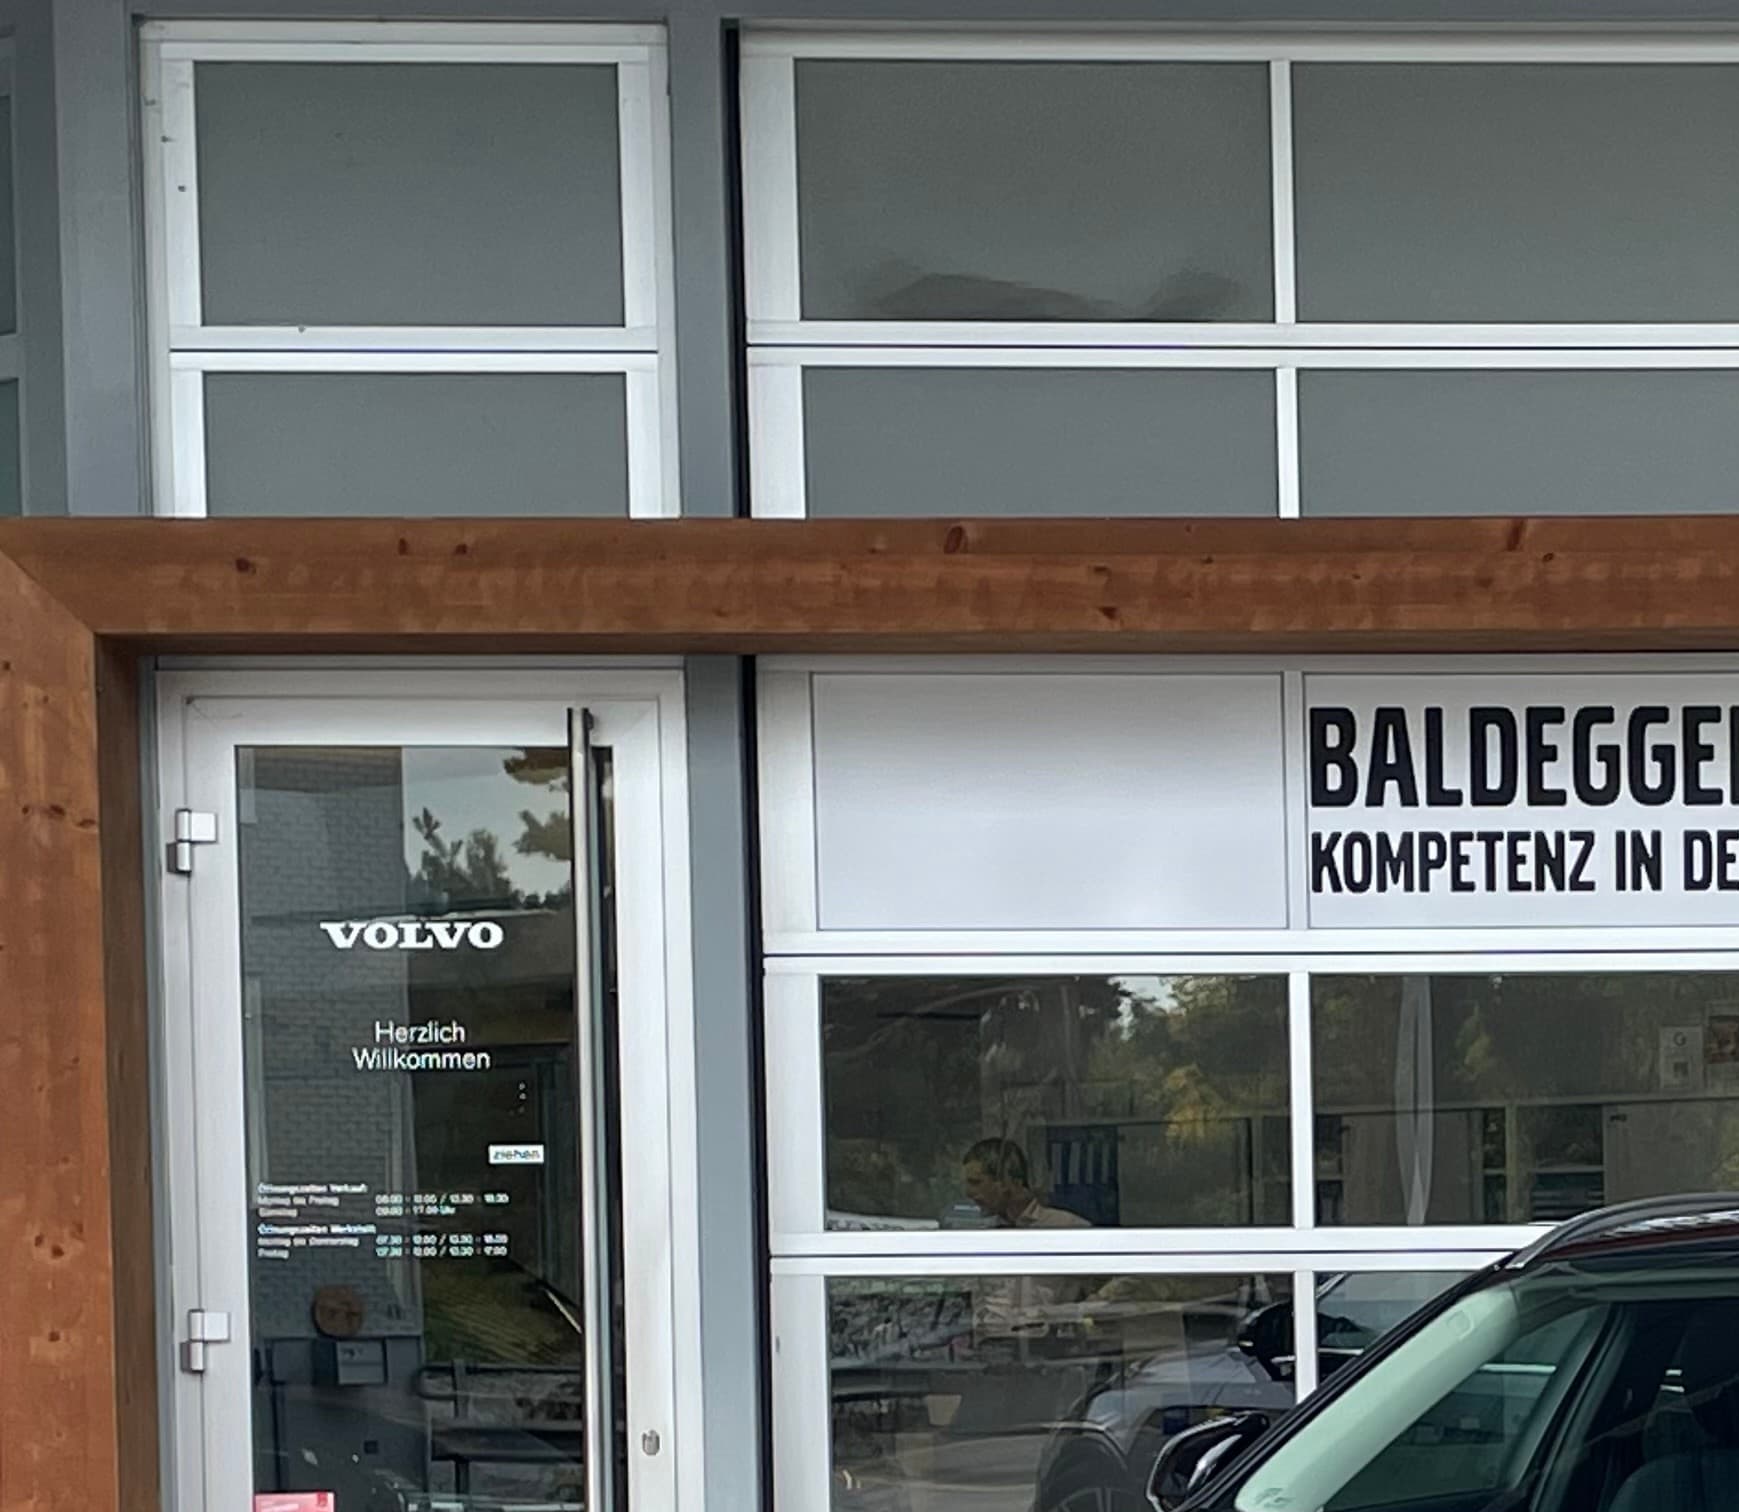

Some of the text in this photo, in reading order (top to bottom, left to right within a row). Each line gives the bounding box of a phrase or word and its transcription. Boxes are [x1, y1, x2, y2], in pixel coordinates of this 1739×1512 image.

[1311, 831, 1597, 893] KOMPETENZ
[1614, 830, 1662, 891] IN
[319, 921, 504, 949] VOLVO
[375, 1020, 466, 1044] Herzlich
[351, 1047, 492, 1071] Willkommen
